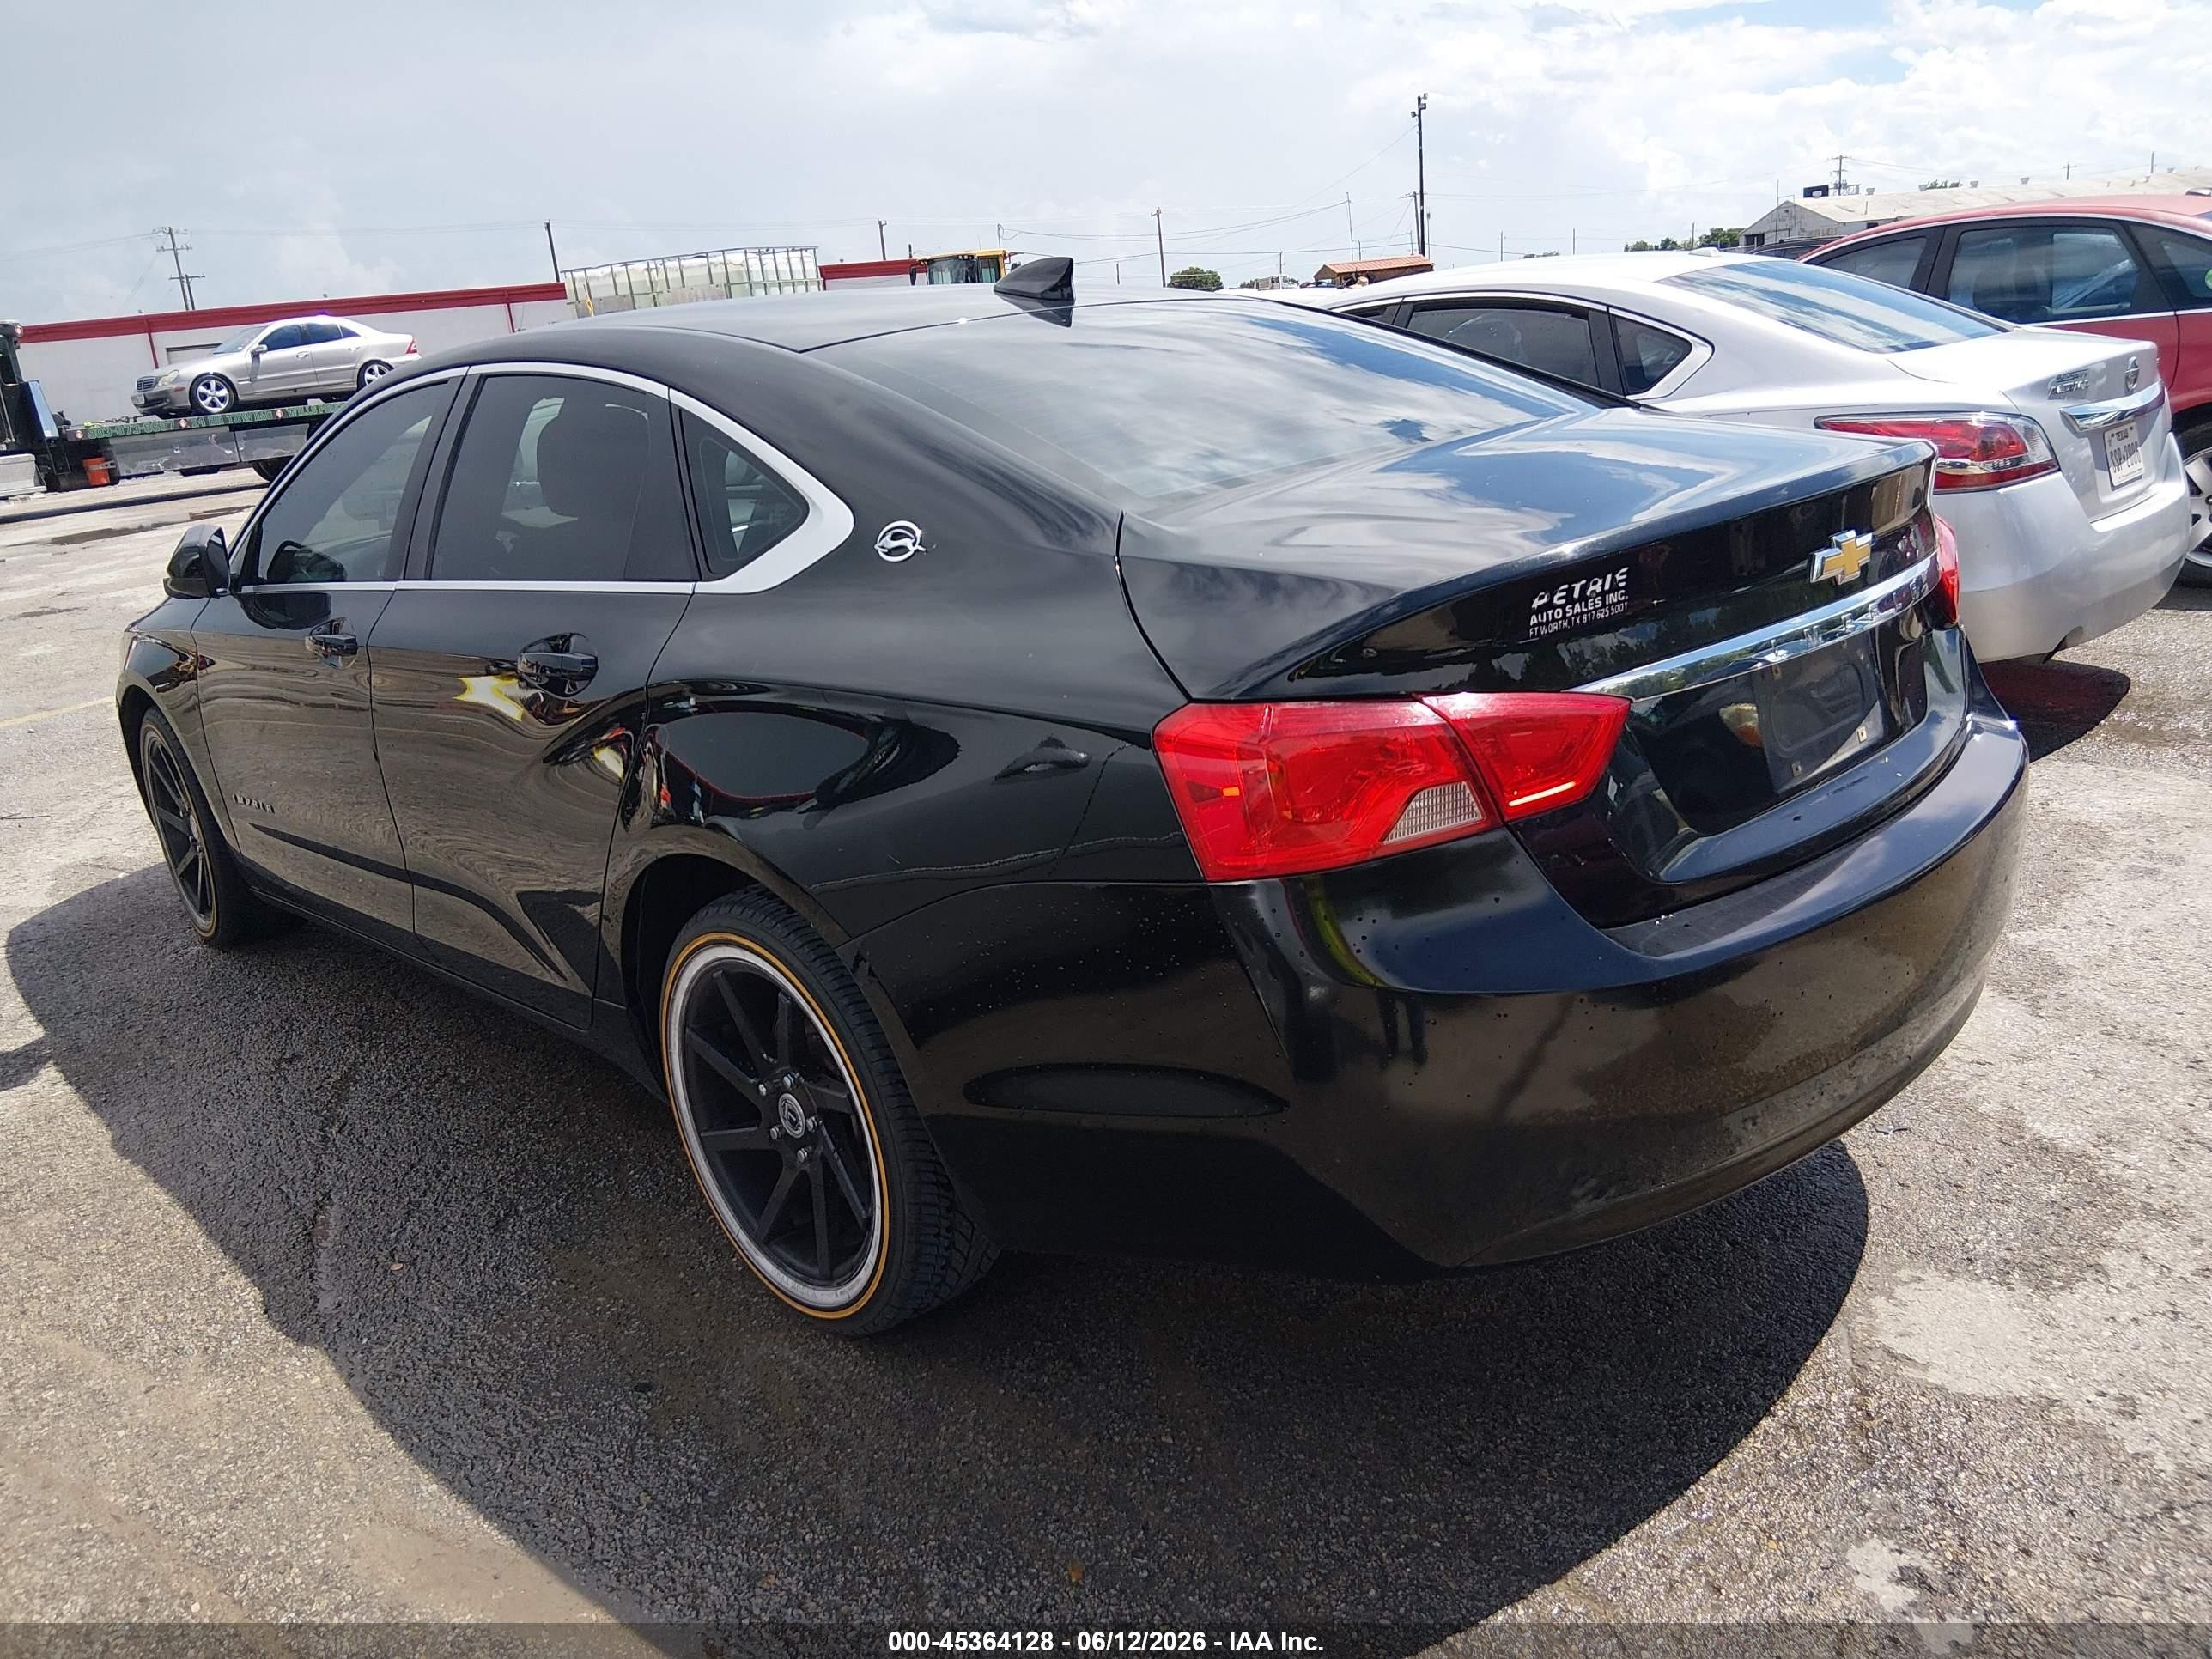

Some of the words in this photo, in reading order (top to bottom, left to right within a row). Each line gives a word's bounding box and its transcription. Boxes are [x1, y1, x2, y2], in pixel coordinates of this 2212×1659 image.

[1531, 567, 1629, 610] PETRIE
[1528, 626, 1539, 639] FT
[1571, 615, 1581, 627] TX
[1583, 611, 1595, 623] 817
[1596, 606, 1610, 620] 625
[1610, 602, 1629, 616] 5001
[1529, 608, 1563, 626] AUTO
[1565, 596, 1602, 617] SALES
[1605, 590, 1629, 605] INC.
[232, 793, 275, 814] IMPALA
